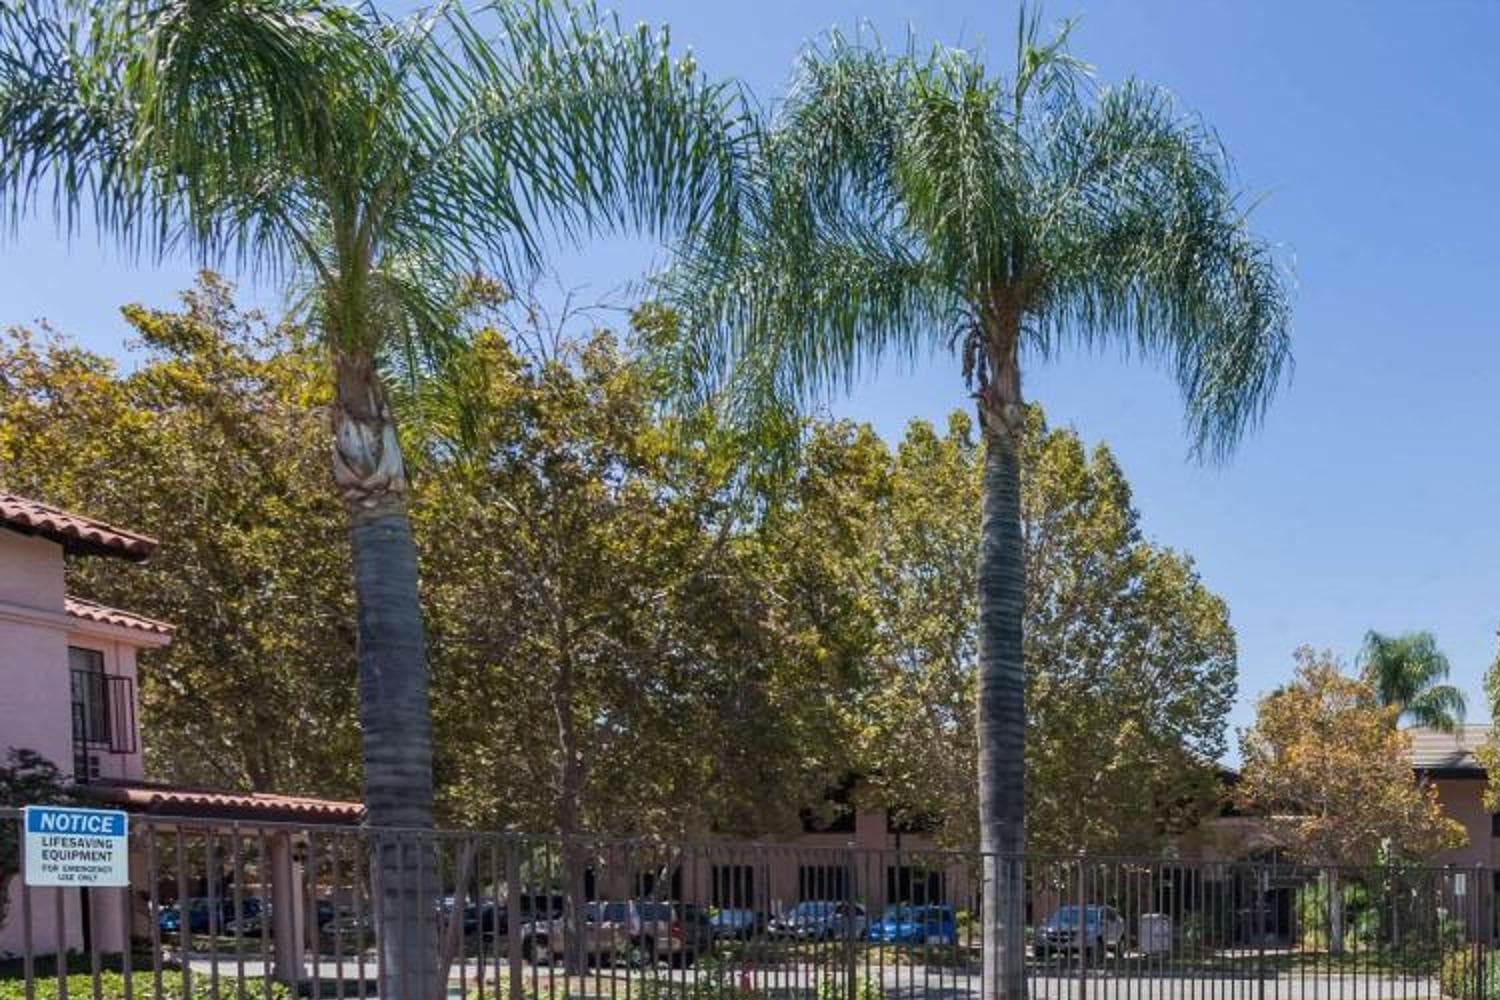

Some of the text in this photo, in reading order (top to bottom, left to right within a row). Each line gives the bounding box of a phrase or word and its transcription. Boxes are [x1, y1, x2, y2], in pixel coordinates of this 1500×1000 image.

[40, 813, 114, 833] NOTICE
[41, 837, 113, 849] LIFESAVING
[41, 850, 113, 862] EQUIPMENT
[41, 864, 59, 872] FOR
